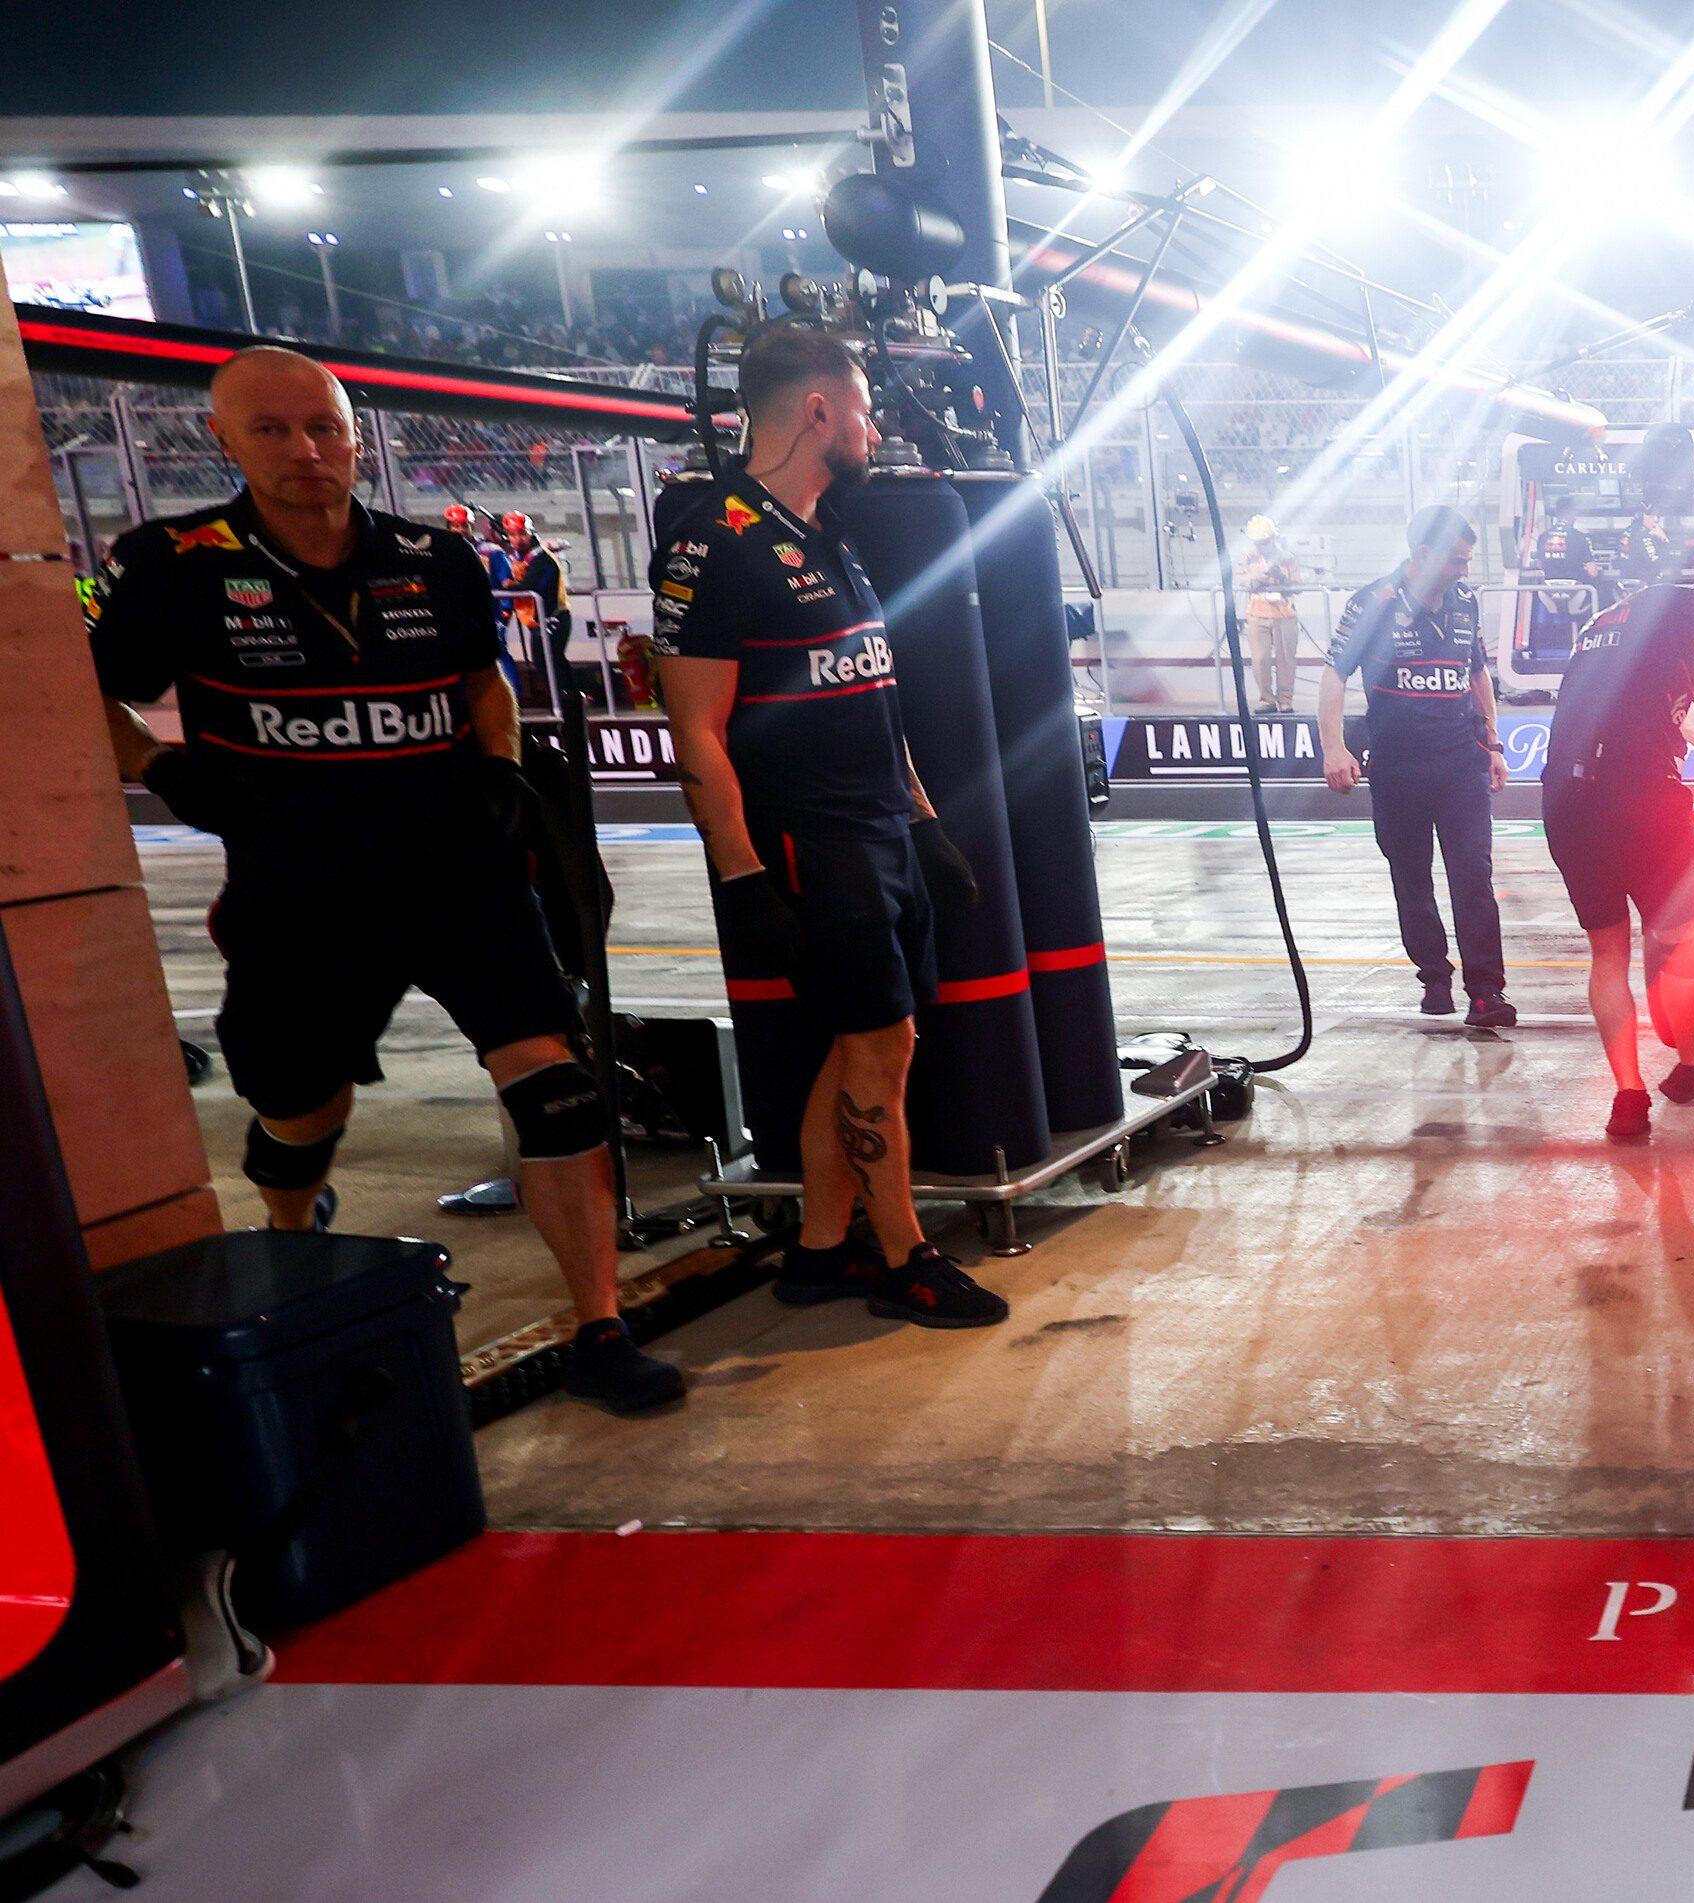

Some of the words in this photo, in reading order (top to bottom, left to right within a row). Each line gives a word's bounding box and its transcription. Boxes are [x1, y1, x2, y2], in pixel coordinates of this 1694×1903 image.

[1554, 462, 1627, 475] CARLYLE
[808, 636, 880, 686] Red
[1397, 667, 1442, 691] Red
[249, 701, 362, 748] Red
[366, 692, 454, 745] Bull
[1144, 723, 1315, 760] LANDMA
